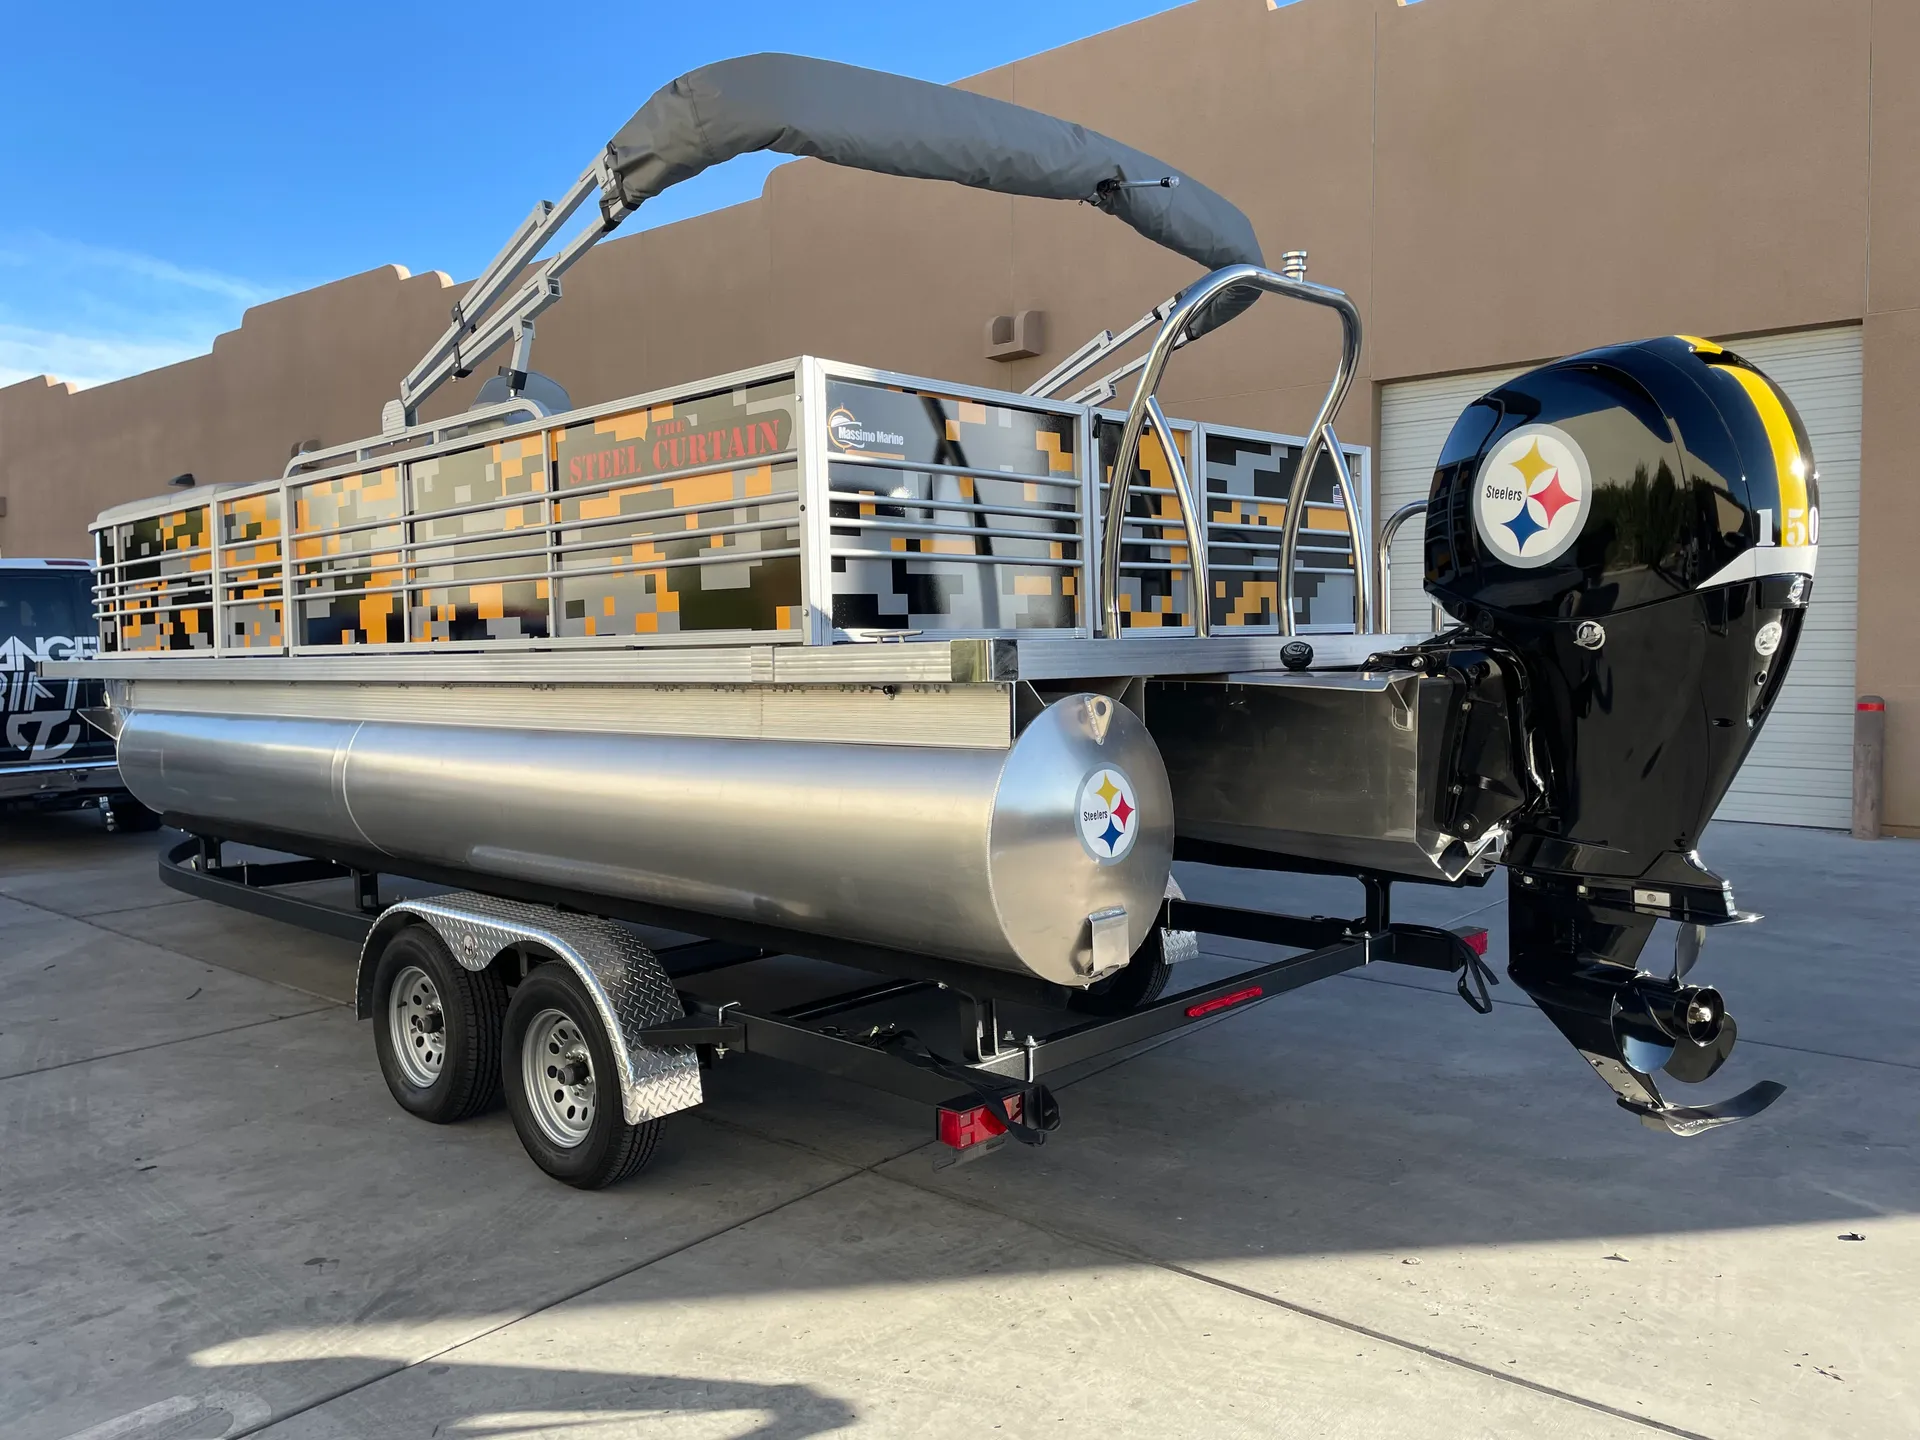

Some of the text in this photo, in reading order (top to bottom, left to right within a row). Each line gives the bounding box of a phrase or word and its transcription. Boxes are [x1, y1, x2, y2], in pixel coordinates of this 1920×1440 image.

[653, 422, 685, 437] THE
[838, 427, 904, 445] Massimo Marine
[569, 419, 779, 484] STEEL CURTAIN
[1486, 485, 1523, 501] Steelers
[1755, 506, 1819, 546] 150
[1083, 810, 1108, 821] Steelers
